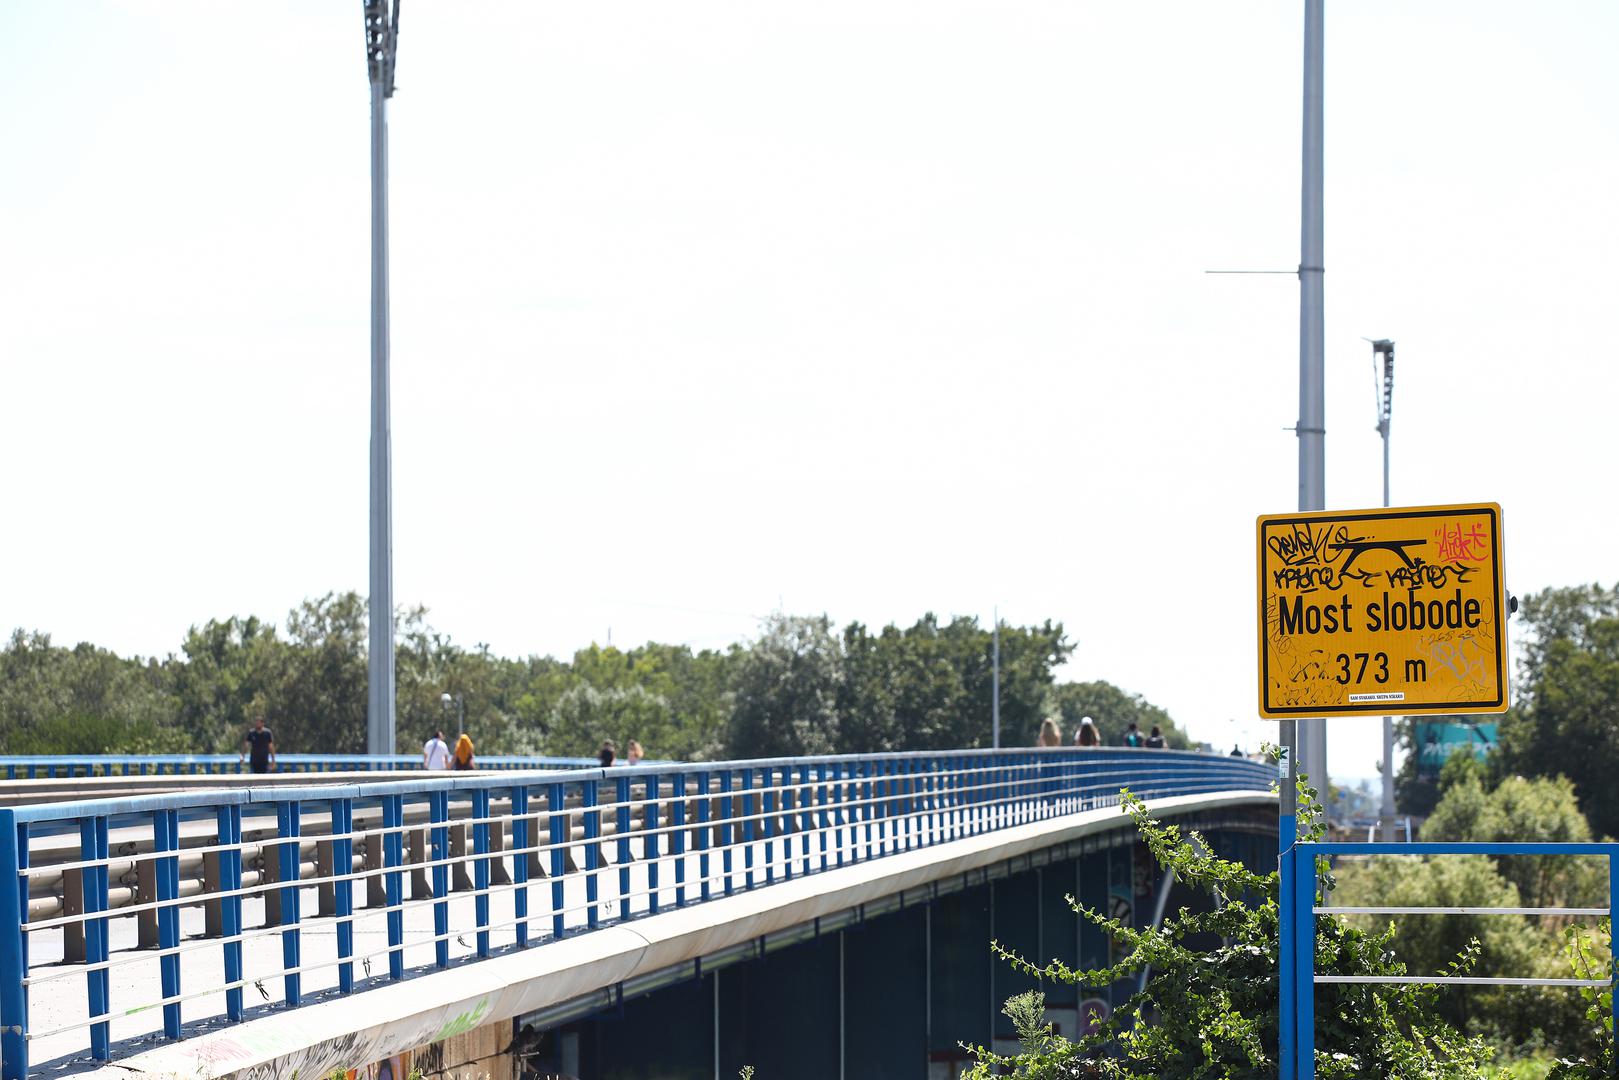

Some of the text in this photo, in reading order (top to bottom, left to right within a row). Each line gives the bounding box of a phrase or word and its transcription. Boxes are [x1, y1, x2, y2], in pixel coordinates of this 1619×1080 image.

[1279, 594, 1353, 635] Most
[1366, 588, 1481, 631] slobode
[1336, 652, 1390, 685] 373
[1405, 659, 1427, 683] m
